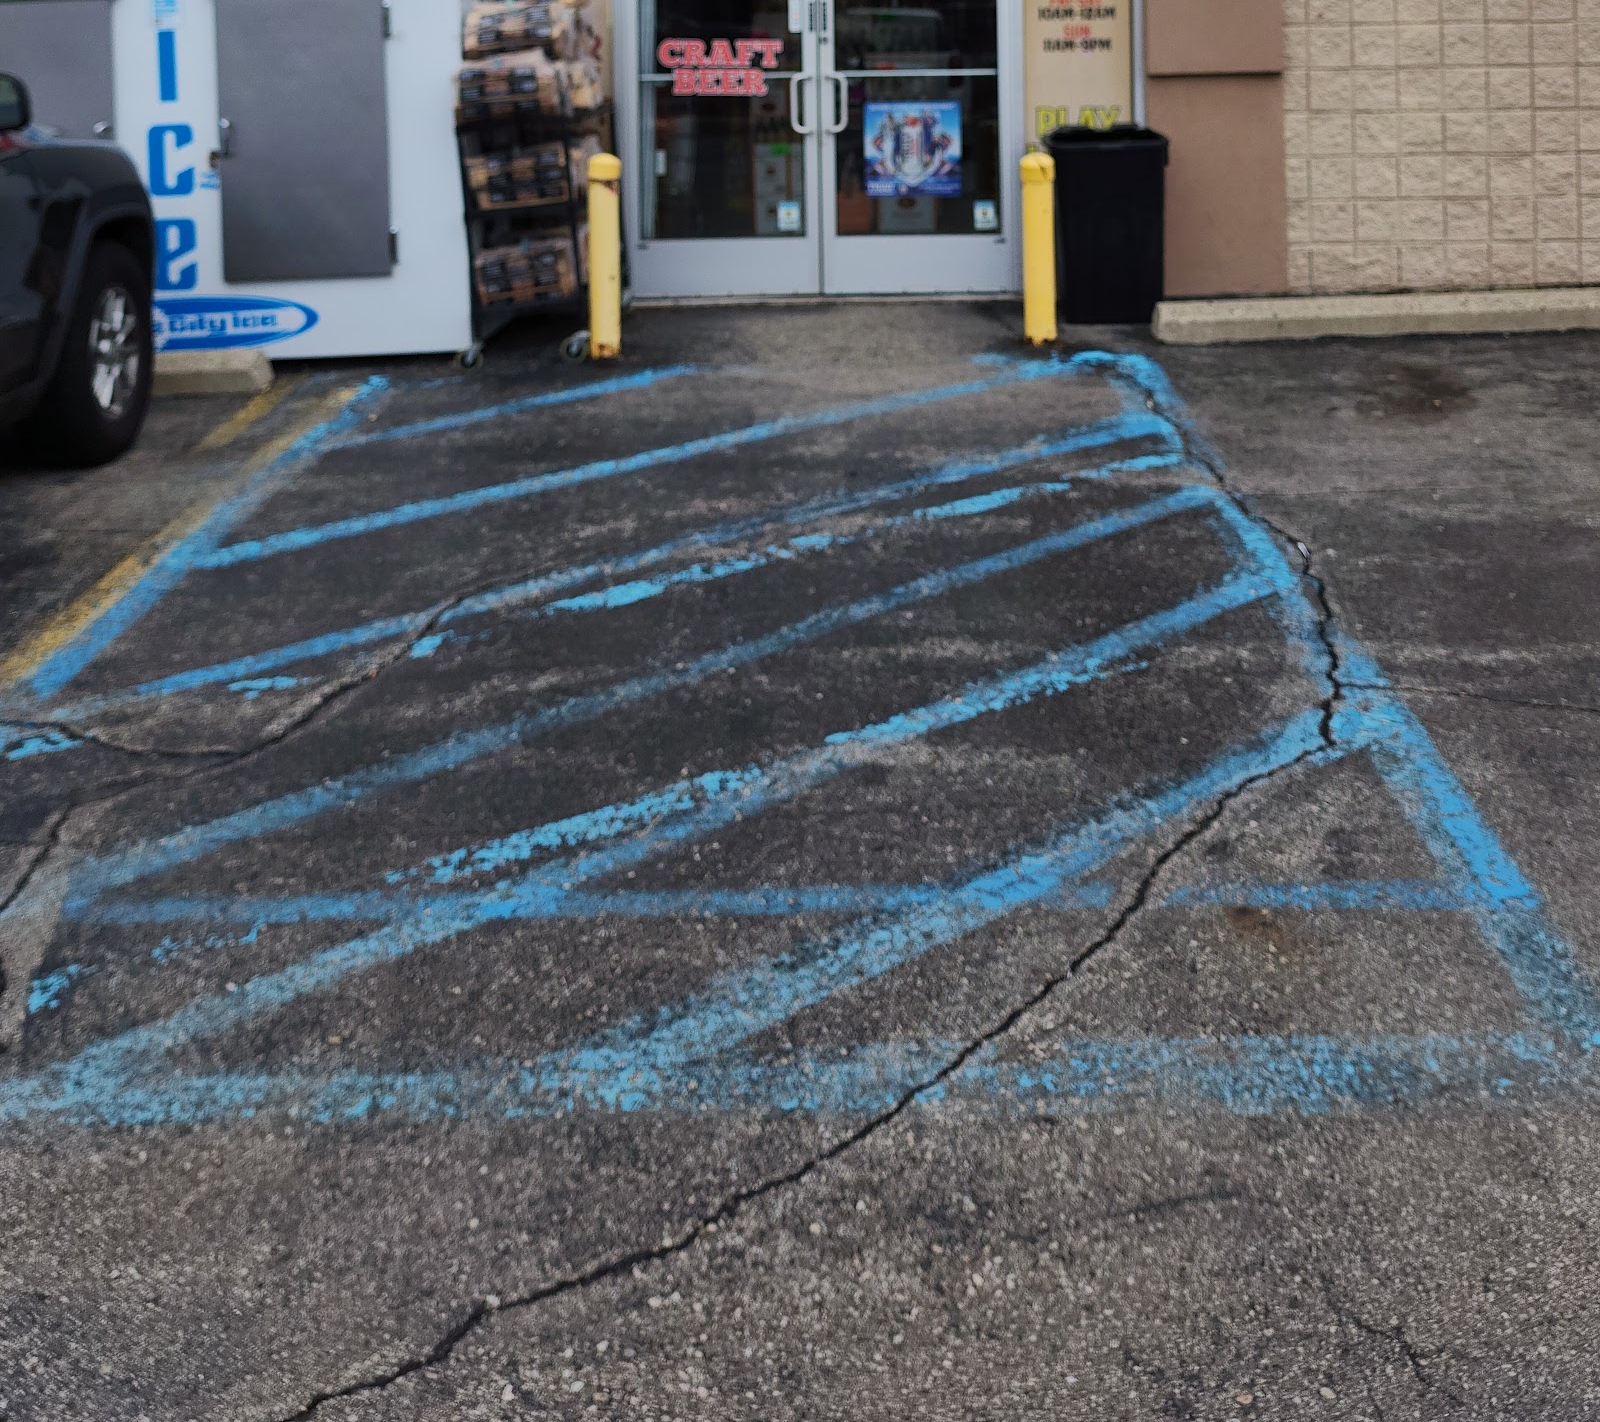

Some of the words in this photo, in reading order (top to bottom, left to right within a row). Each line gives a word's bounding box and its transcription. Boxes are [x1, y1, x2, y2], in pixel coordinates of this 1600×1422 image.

[657, 37, 785, 69] CRAFT
[671, 67, 769, 97] BEER
[1036, 105, 1120, 137] PLAY
